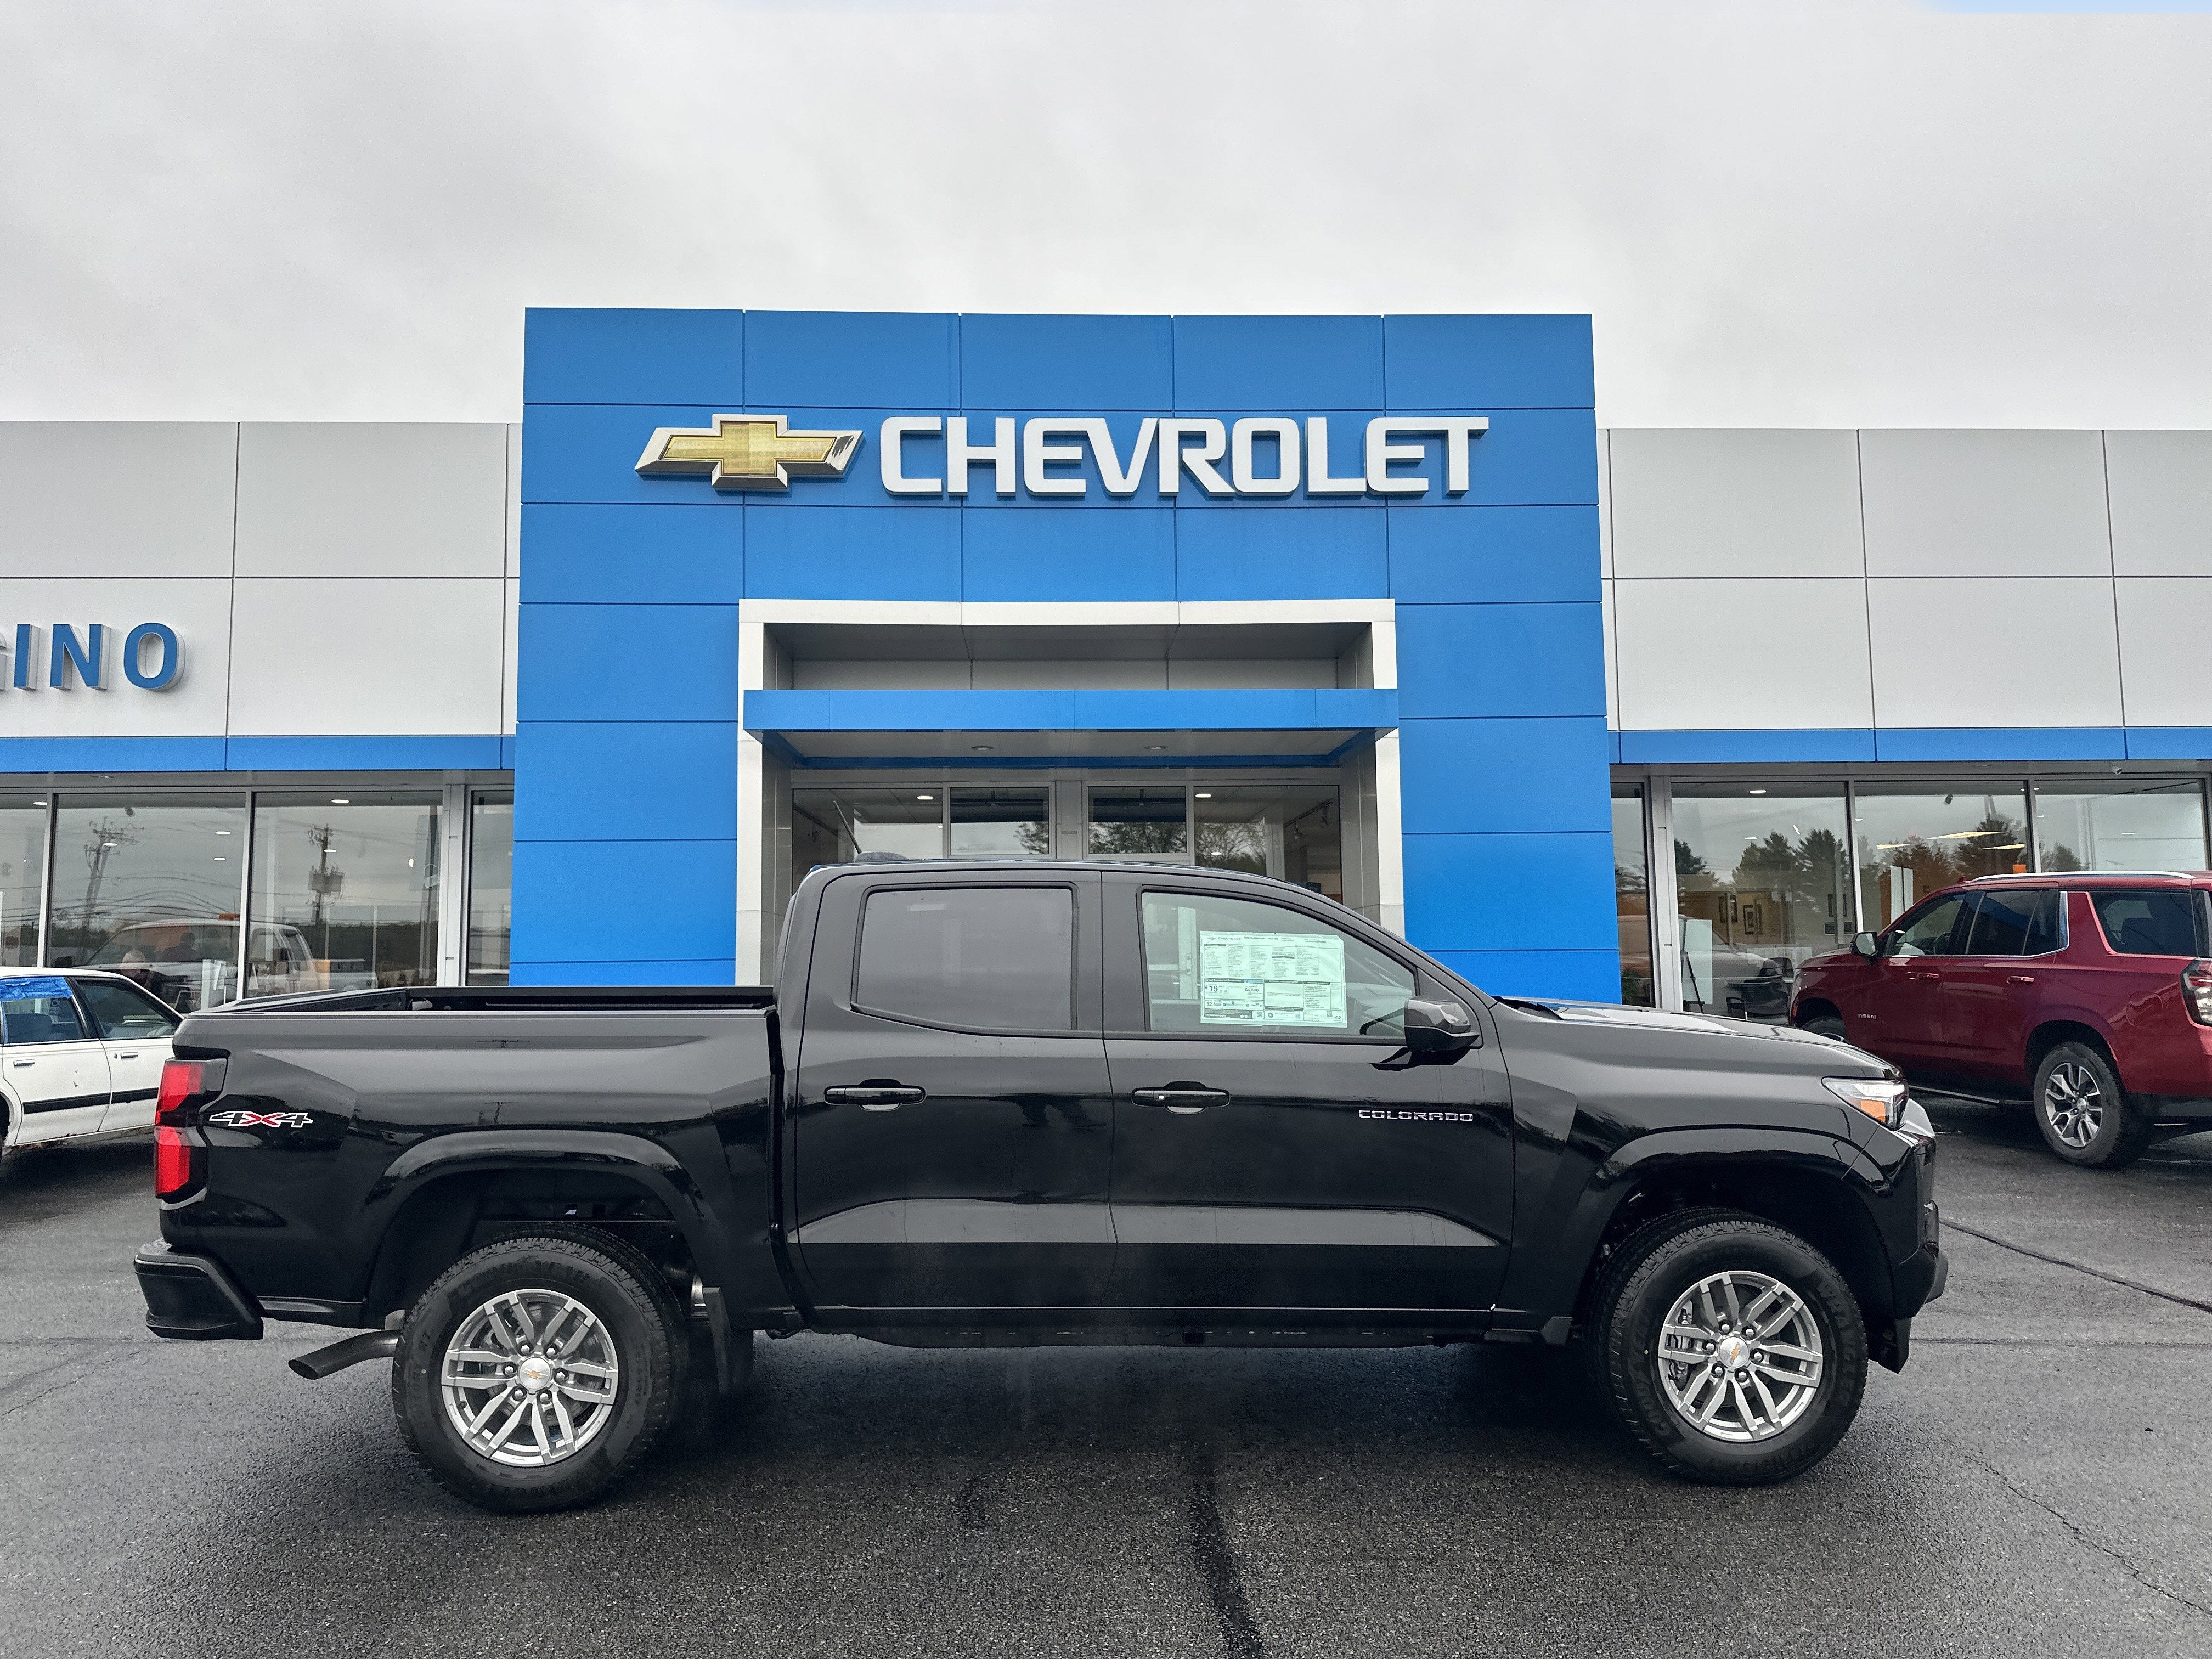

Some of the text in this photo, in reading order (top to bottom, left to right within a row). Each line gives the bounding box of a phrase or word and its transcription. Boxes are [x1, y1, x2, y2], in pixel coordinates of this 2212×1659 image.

[880, 415, 1489, 495] CHEVROLET
[0, 622, 186, 692] INO
[1358, 1110, 1474, 1122] COLORADO
